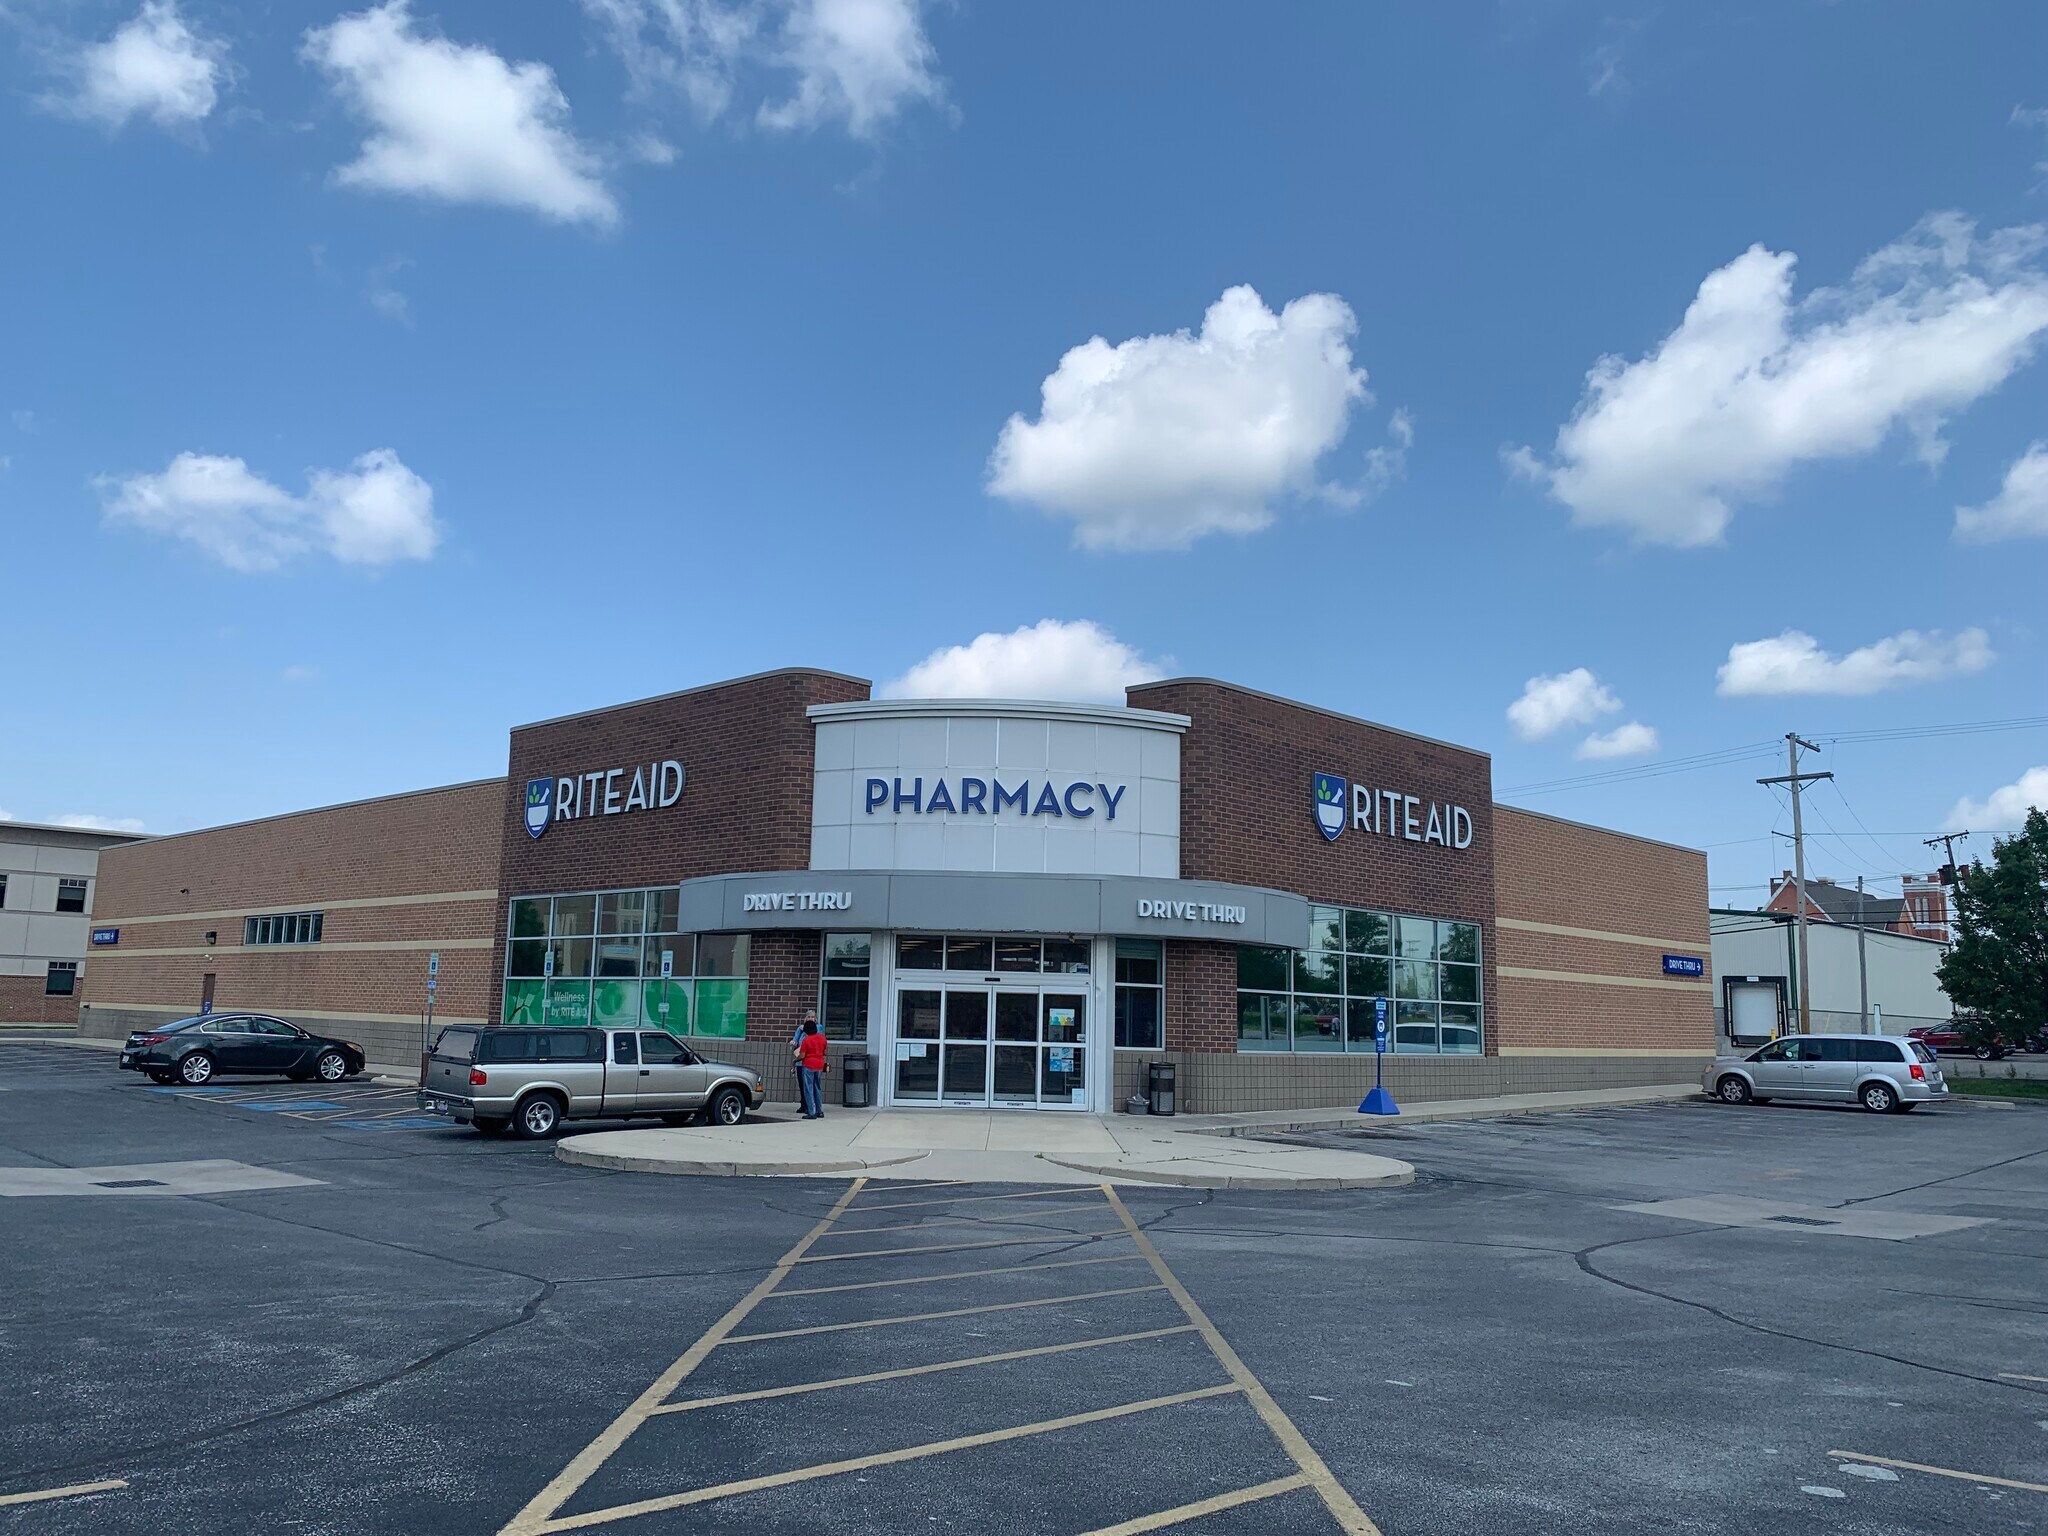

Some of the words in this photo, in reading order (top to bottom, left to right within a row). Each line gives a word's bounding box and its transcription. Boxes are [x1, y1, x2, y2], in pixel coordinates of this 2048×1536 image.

[555, 768, 624, 821] RITE
[624, 760, 685, 812] AID
[866, 777, 1127, 820] PHARMACY
[1352, 783, 1421, 841] RITE
[1424, 801, 1473, 849] AID
[743, 892, 796, 911] DRIVE
[797, 891, 852, 910] THRU
[1137, 899, 1197, 920] DRIVE
[1198, 903, 1246, 924] THRU
[1669, 959, 1683, 970] DRIVE
[1683, 960, 1696, 971] THRU
[554, 991, 585, 1002] Wellness
[551, 1006, 560, 1018] by
[561, 1007, 575, 1017] RITE
